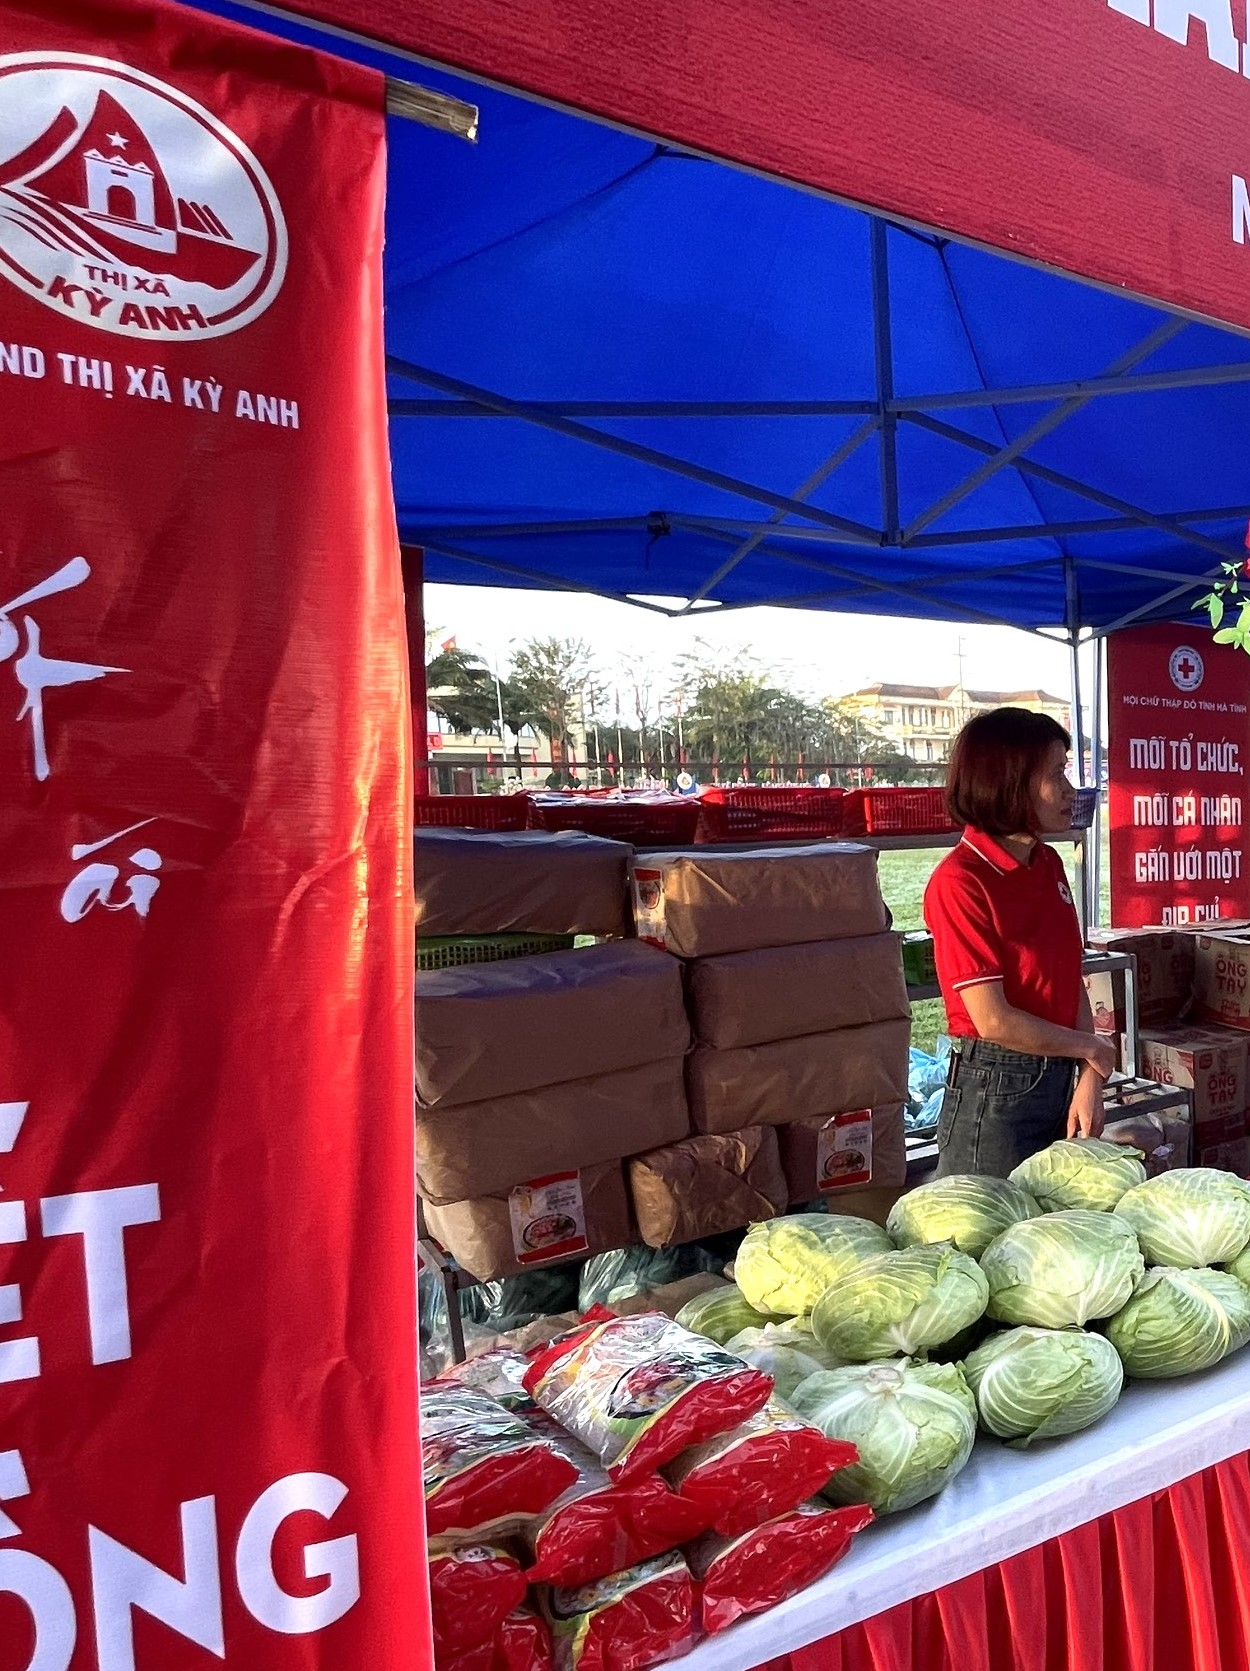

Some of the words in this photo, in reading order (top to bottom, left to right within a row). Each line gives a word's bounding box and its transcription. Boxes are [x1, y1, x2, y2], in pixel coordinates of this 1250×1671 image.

[83, 264, 128, 291] THỊ
[134, 276, 171, 298] XÃ
[47, 275, 113, 318] KỲ
[118, 302, 208, 331] ANH
[57, 352, 113, 399] THỊ
[125, 365, 172, 403] XÃ
[183, 376, 222, 413] KỲ
[235, 390, 299, 429] ANH
[1123, 696, 1138, 706] HỘI
[1130, 736, 1166, 770] MỖI
[1169, 732, 1194, 770] TỔ
[1133, 792, 1169, 826] MỖI
[1172, 789, 1196, 826] CÁ
[1201, 794, 1242, 826] NHÂN
[1135, 844, 1169, 883] GẮN
[1206, 847, 1242, 884] MỘT
